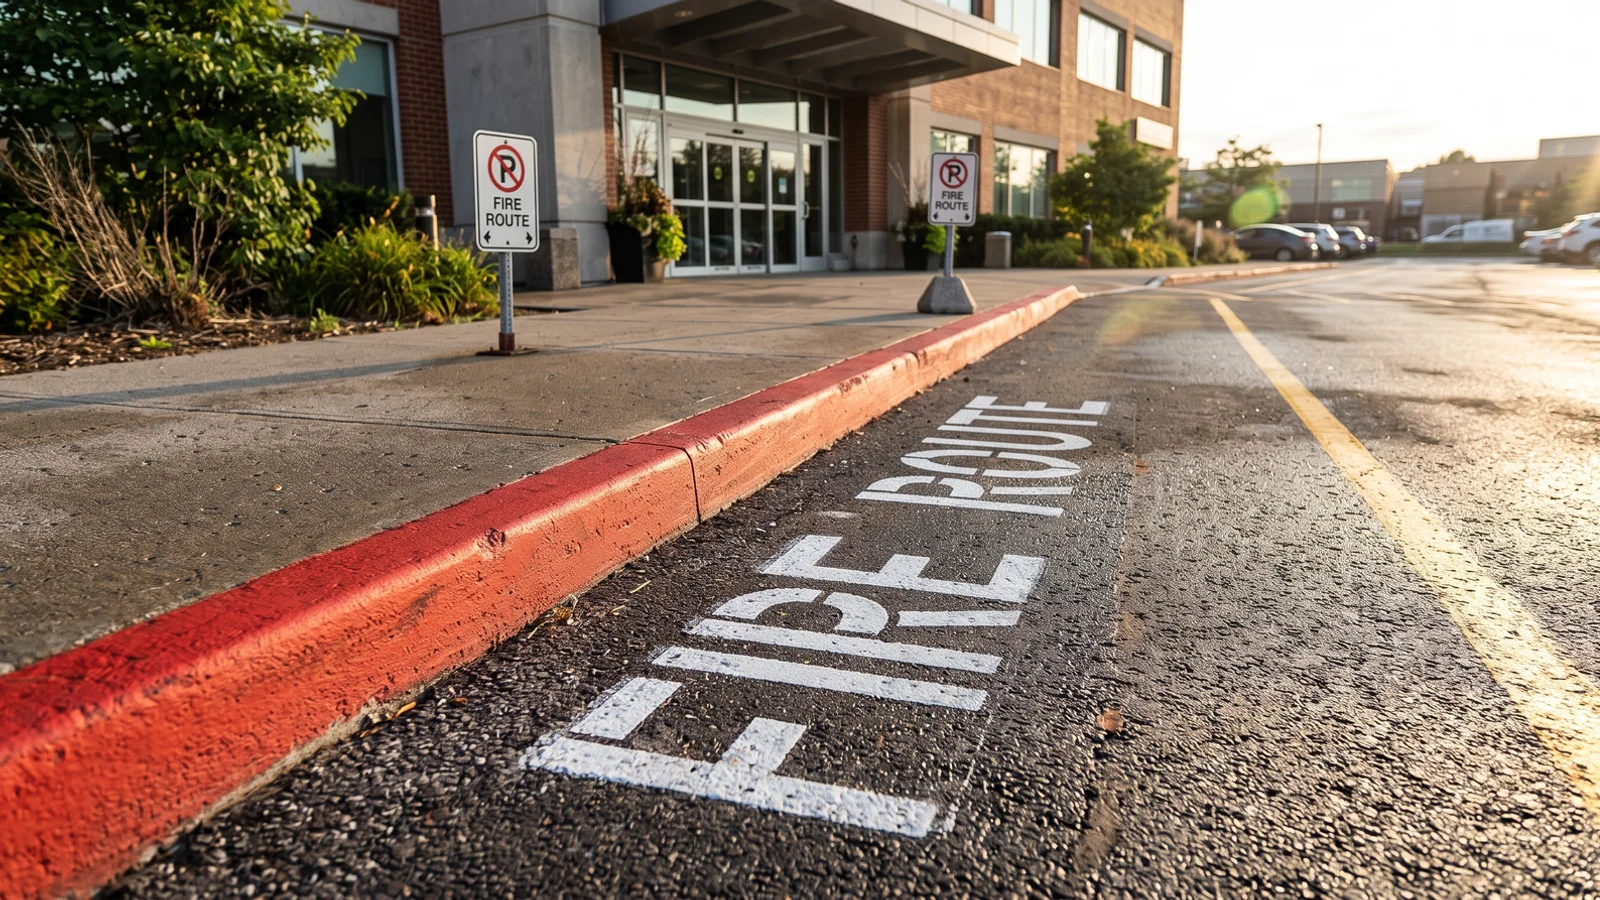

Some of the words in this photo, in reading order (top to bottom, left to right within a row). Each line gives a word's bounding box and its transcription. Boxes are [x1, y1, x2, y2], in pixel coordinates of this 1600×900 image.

[941, 191, 964, 200] FIRE
[493, 197, 522, 211] FIRE
[935, 201, 969, 211] ROUTE
[485, 213, 530, 227] ROUTE
[521, 535, 1045, 837] FIRE
[856, 395, 1109, 517] ROUTE
